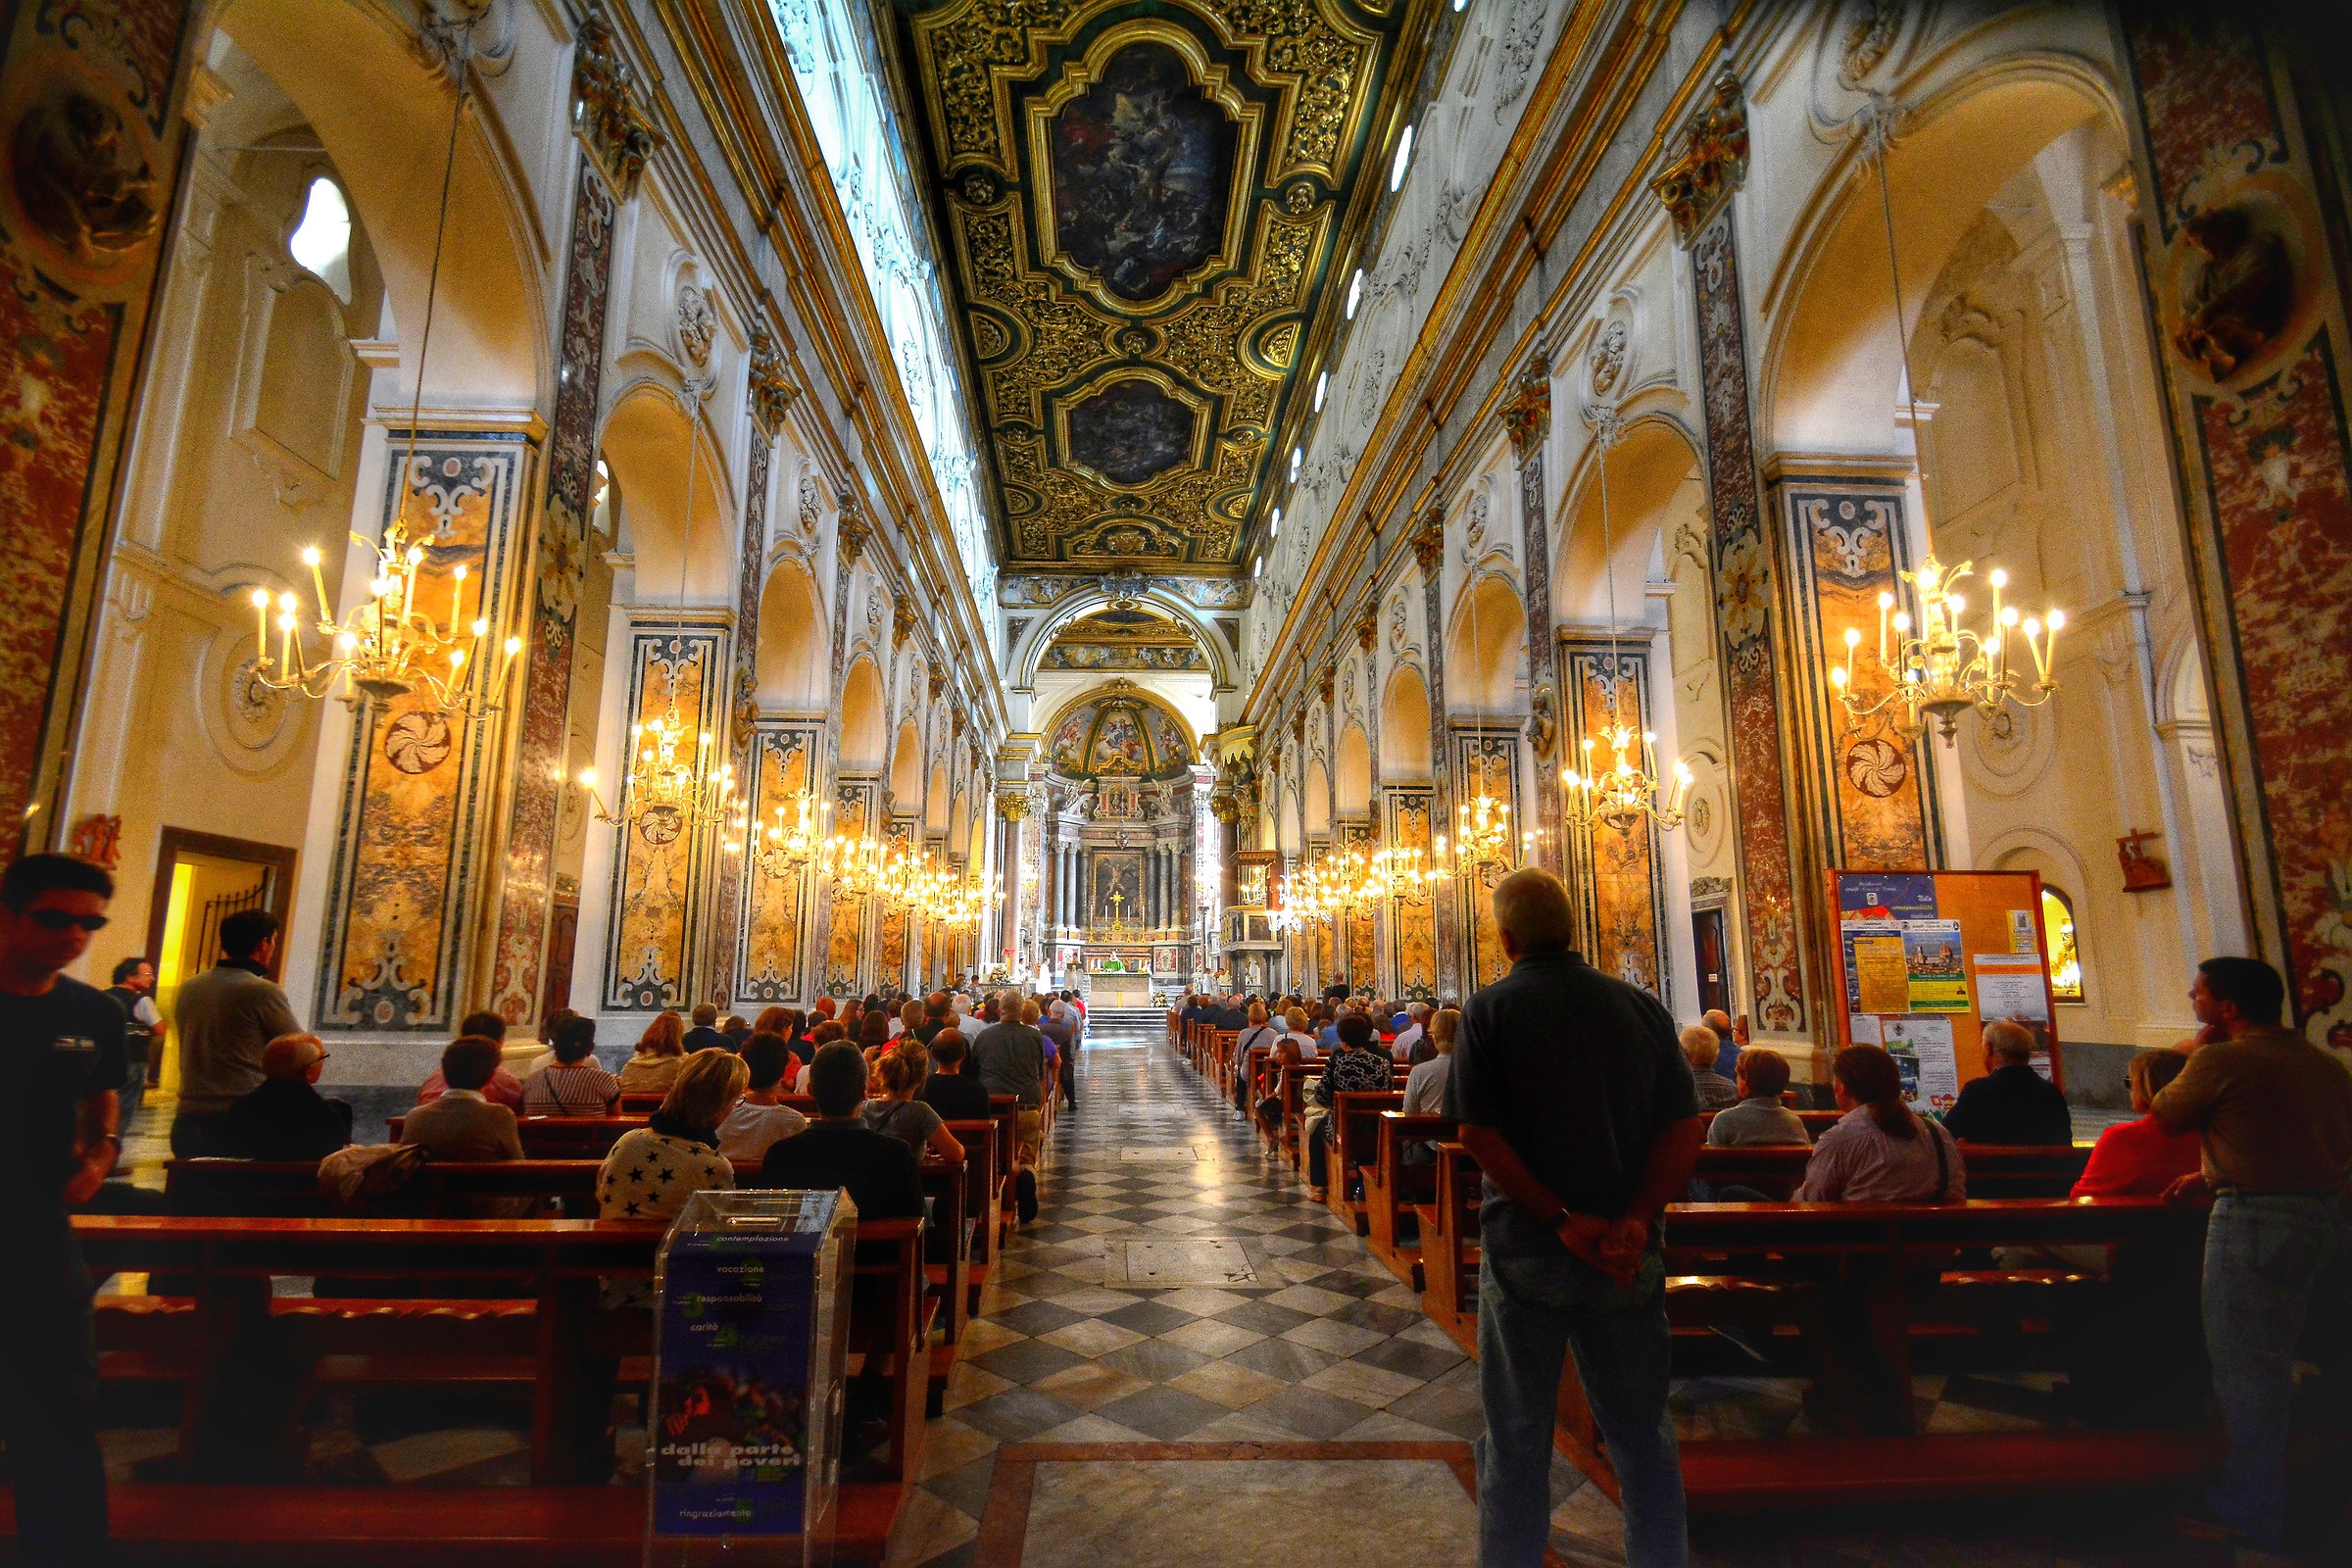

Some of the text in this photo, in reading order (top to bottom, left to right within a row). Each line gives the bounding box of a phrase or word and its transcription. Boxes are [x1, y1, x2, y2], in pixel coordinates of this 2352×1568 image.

[716, 1235, 790, 1245] contemplazione
[716, 1264, 764, 1274] vocazione
[697, 1293, 762, 1305] responsabilità
[690, 1322, 718, 1332] carità
[729, 1443, 795, 1459] parte
[723, 1453, 801, 1470] poveri
[679, 1508, 752, 1519] ringraziamento
